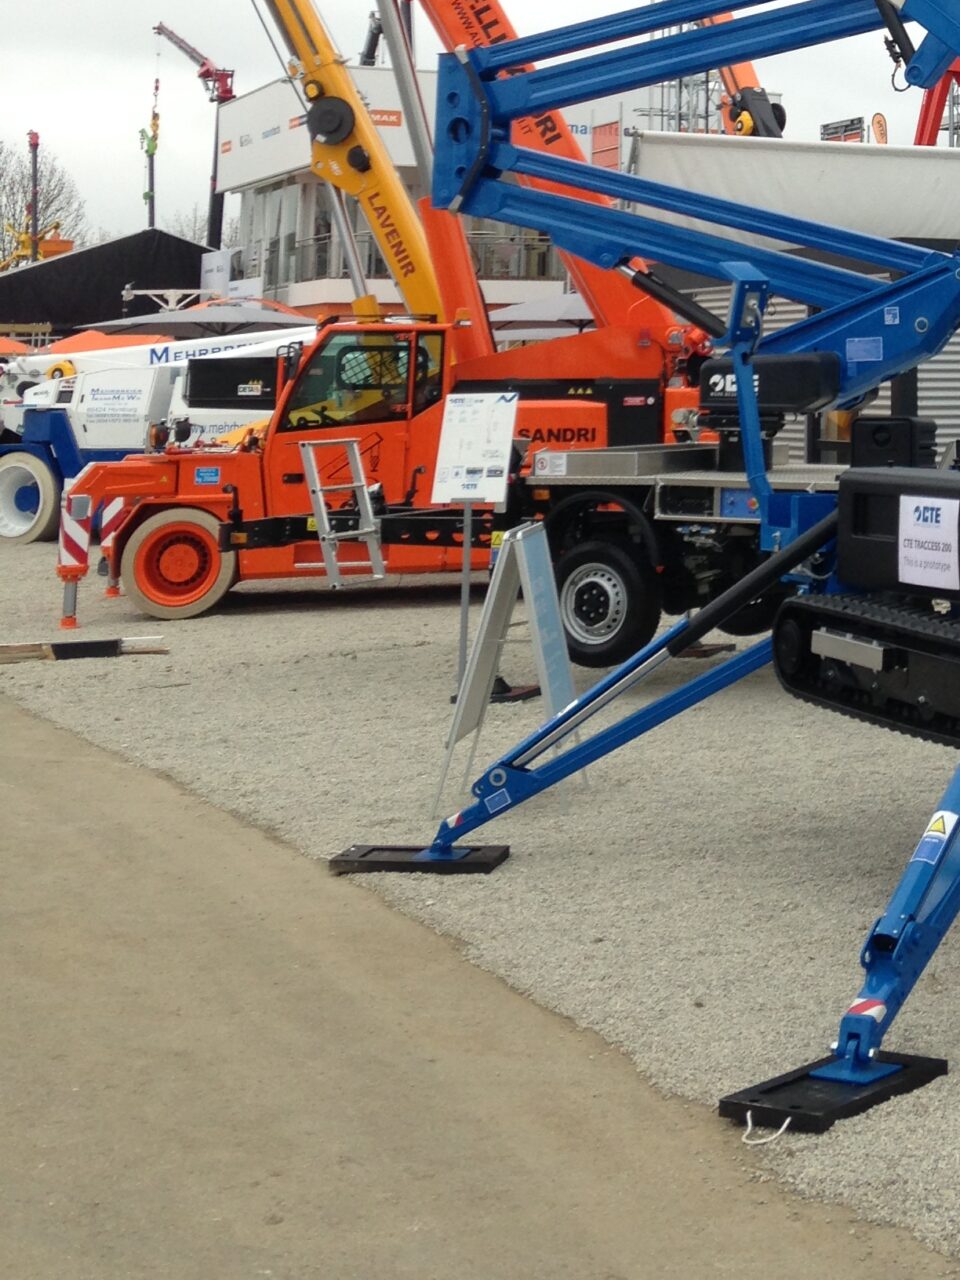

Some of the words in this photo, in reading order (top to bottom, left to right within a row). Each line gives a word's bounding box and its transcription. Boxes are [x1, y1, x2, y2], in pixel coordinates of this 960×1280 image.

[368, 192, 416, 278] LAVENIR
[922, 506, 941, 523] CTE
[903, 538, 913, 549] CTE
[914, 539, 941, 551] TRACCESS
[941, 542, 952, 553] 200
